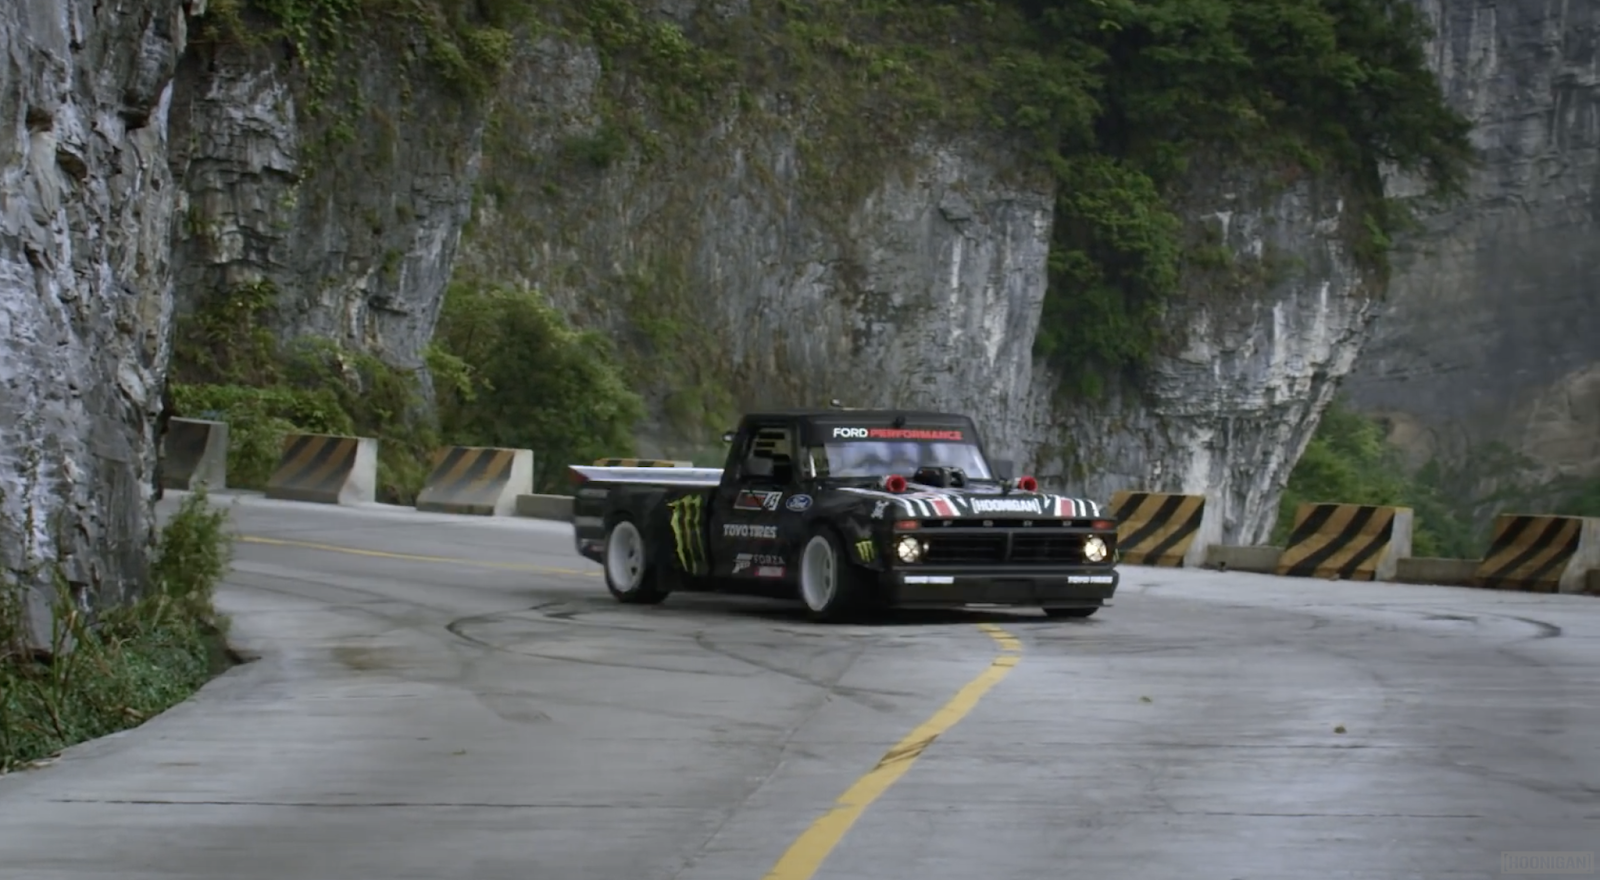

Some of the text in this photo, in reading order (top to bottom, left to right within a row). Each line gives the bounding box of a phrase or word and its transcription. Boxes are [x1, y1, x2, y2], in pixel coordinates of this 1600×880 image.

[833, 427, 963, 440] FORD PERFORMANCE
[723, 524, 777, 538] TOYO TIRES
[753, 554, 785, 564] FORZA
